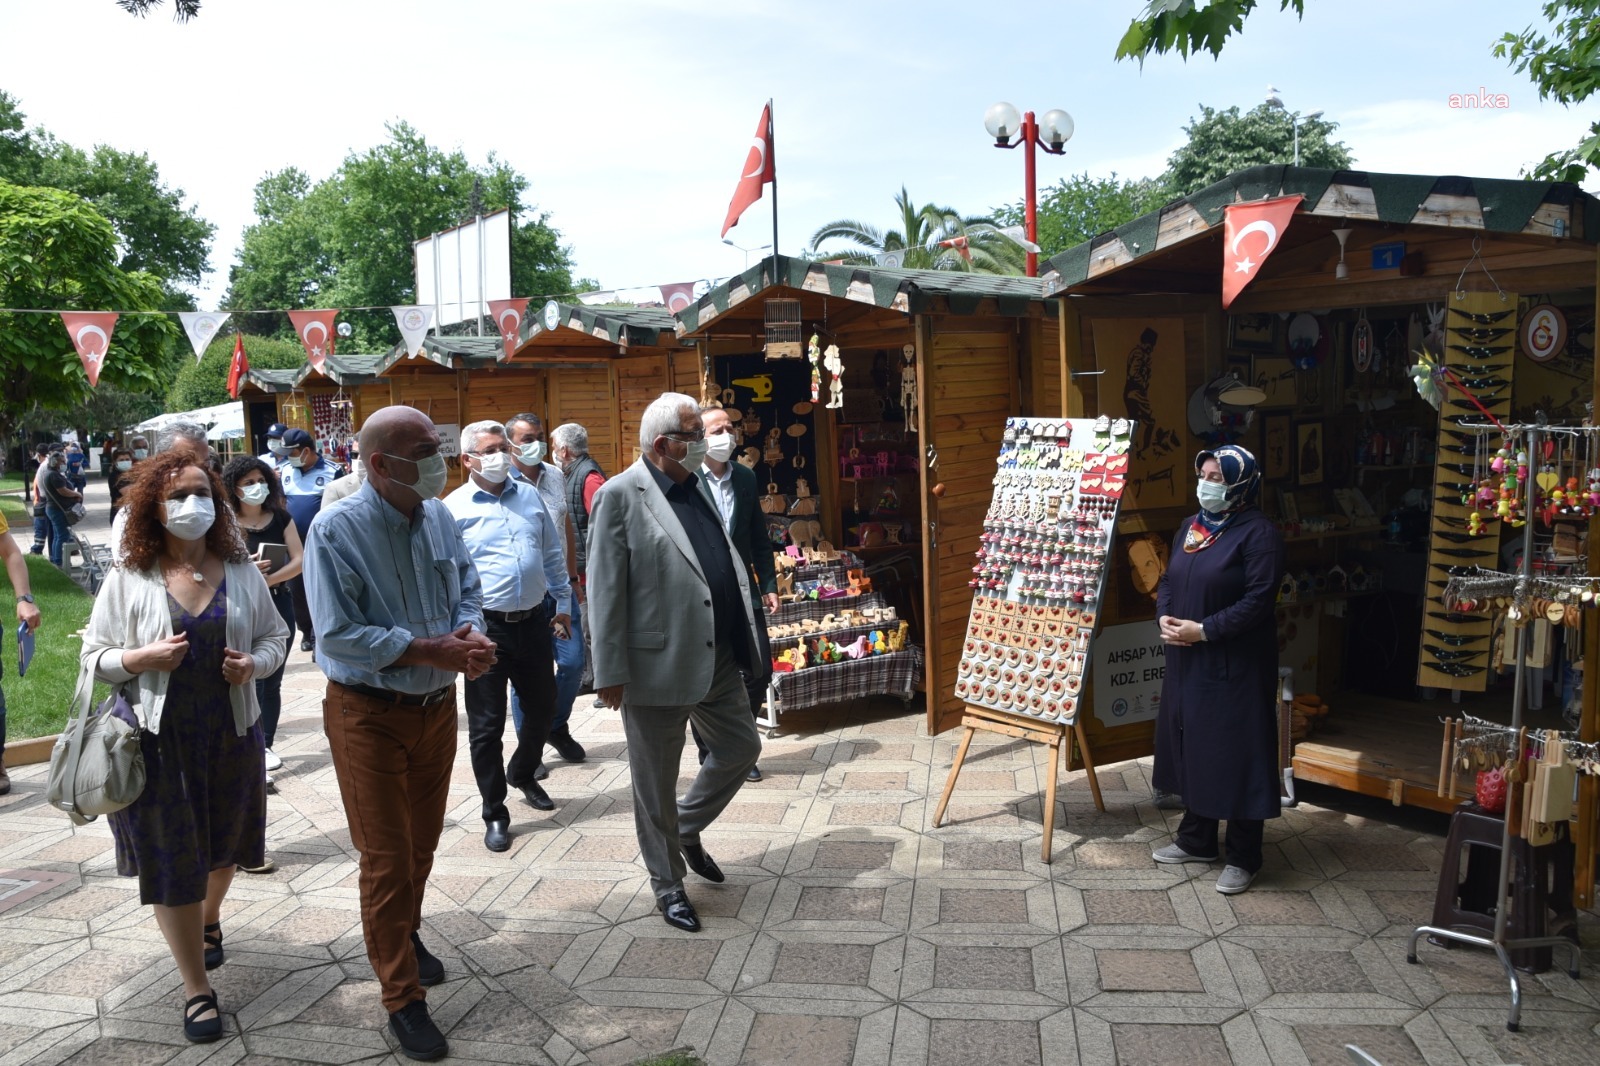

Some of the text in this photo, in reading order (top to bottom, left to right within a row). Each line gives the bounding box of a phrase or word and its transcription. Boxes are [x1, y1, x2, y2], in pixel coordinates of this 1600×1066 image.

[1382, 251, 1392, 265] 1
[1107, 644, 1166, 664] AHŞAP YA
[1110, 671, 1139, 687] KDZ.
